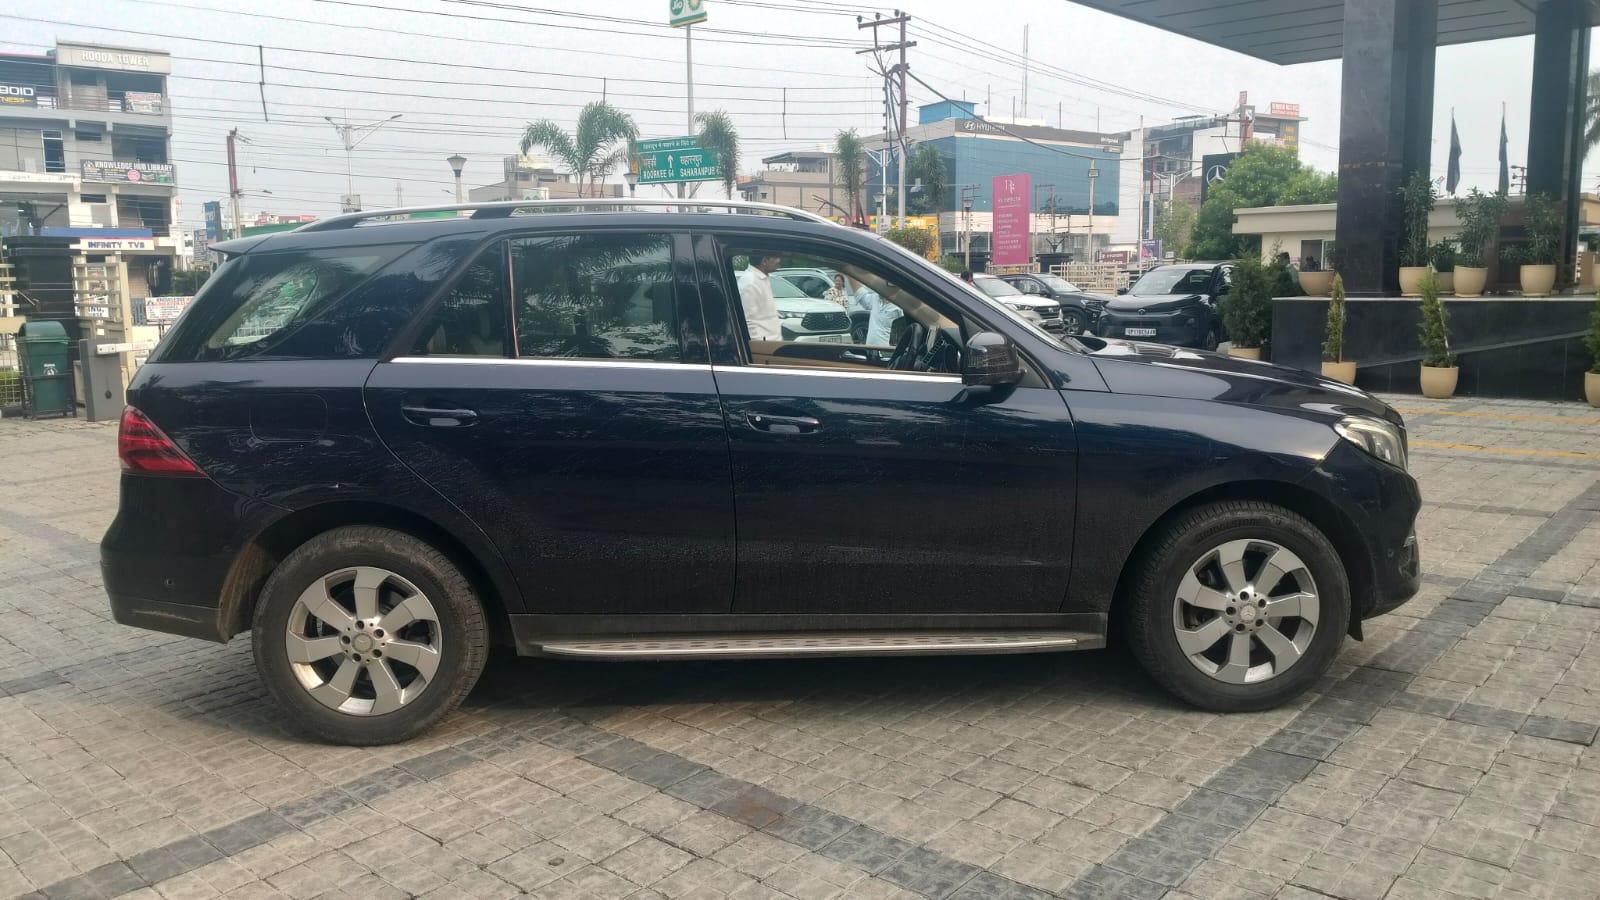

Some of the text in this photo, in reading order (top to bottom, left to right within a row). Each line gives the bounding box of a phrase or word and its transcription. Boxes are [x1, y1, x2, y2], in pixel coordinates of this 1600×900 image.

[117, 54, 149, 66] TOWER
[95, 161, 133, 170] KNOWLEDGE
[147, 163, 173, 171] LIBRARY
[679, 166, 716, 178] SAHARANPUR
[87, 241, 122, 249] INFINITY
